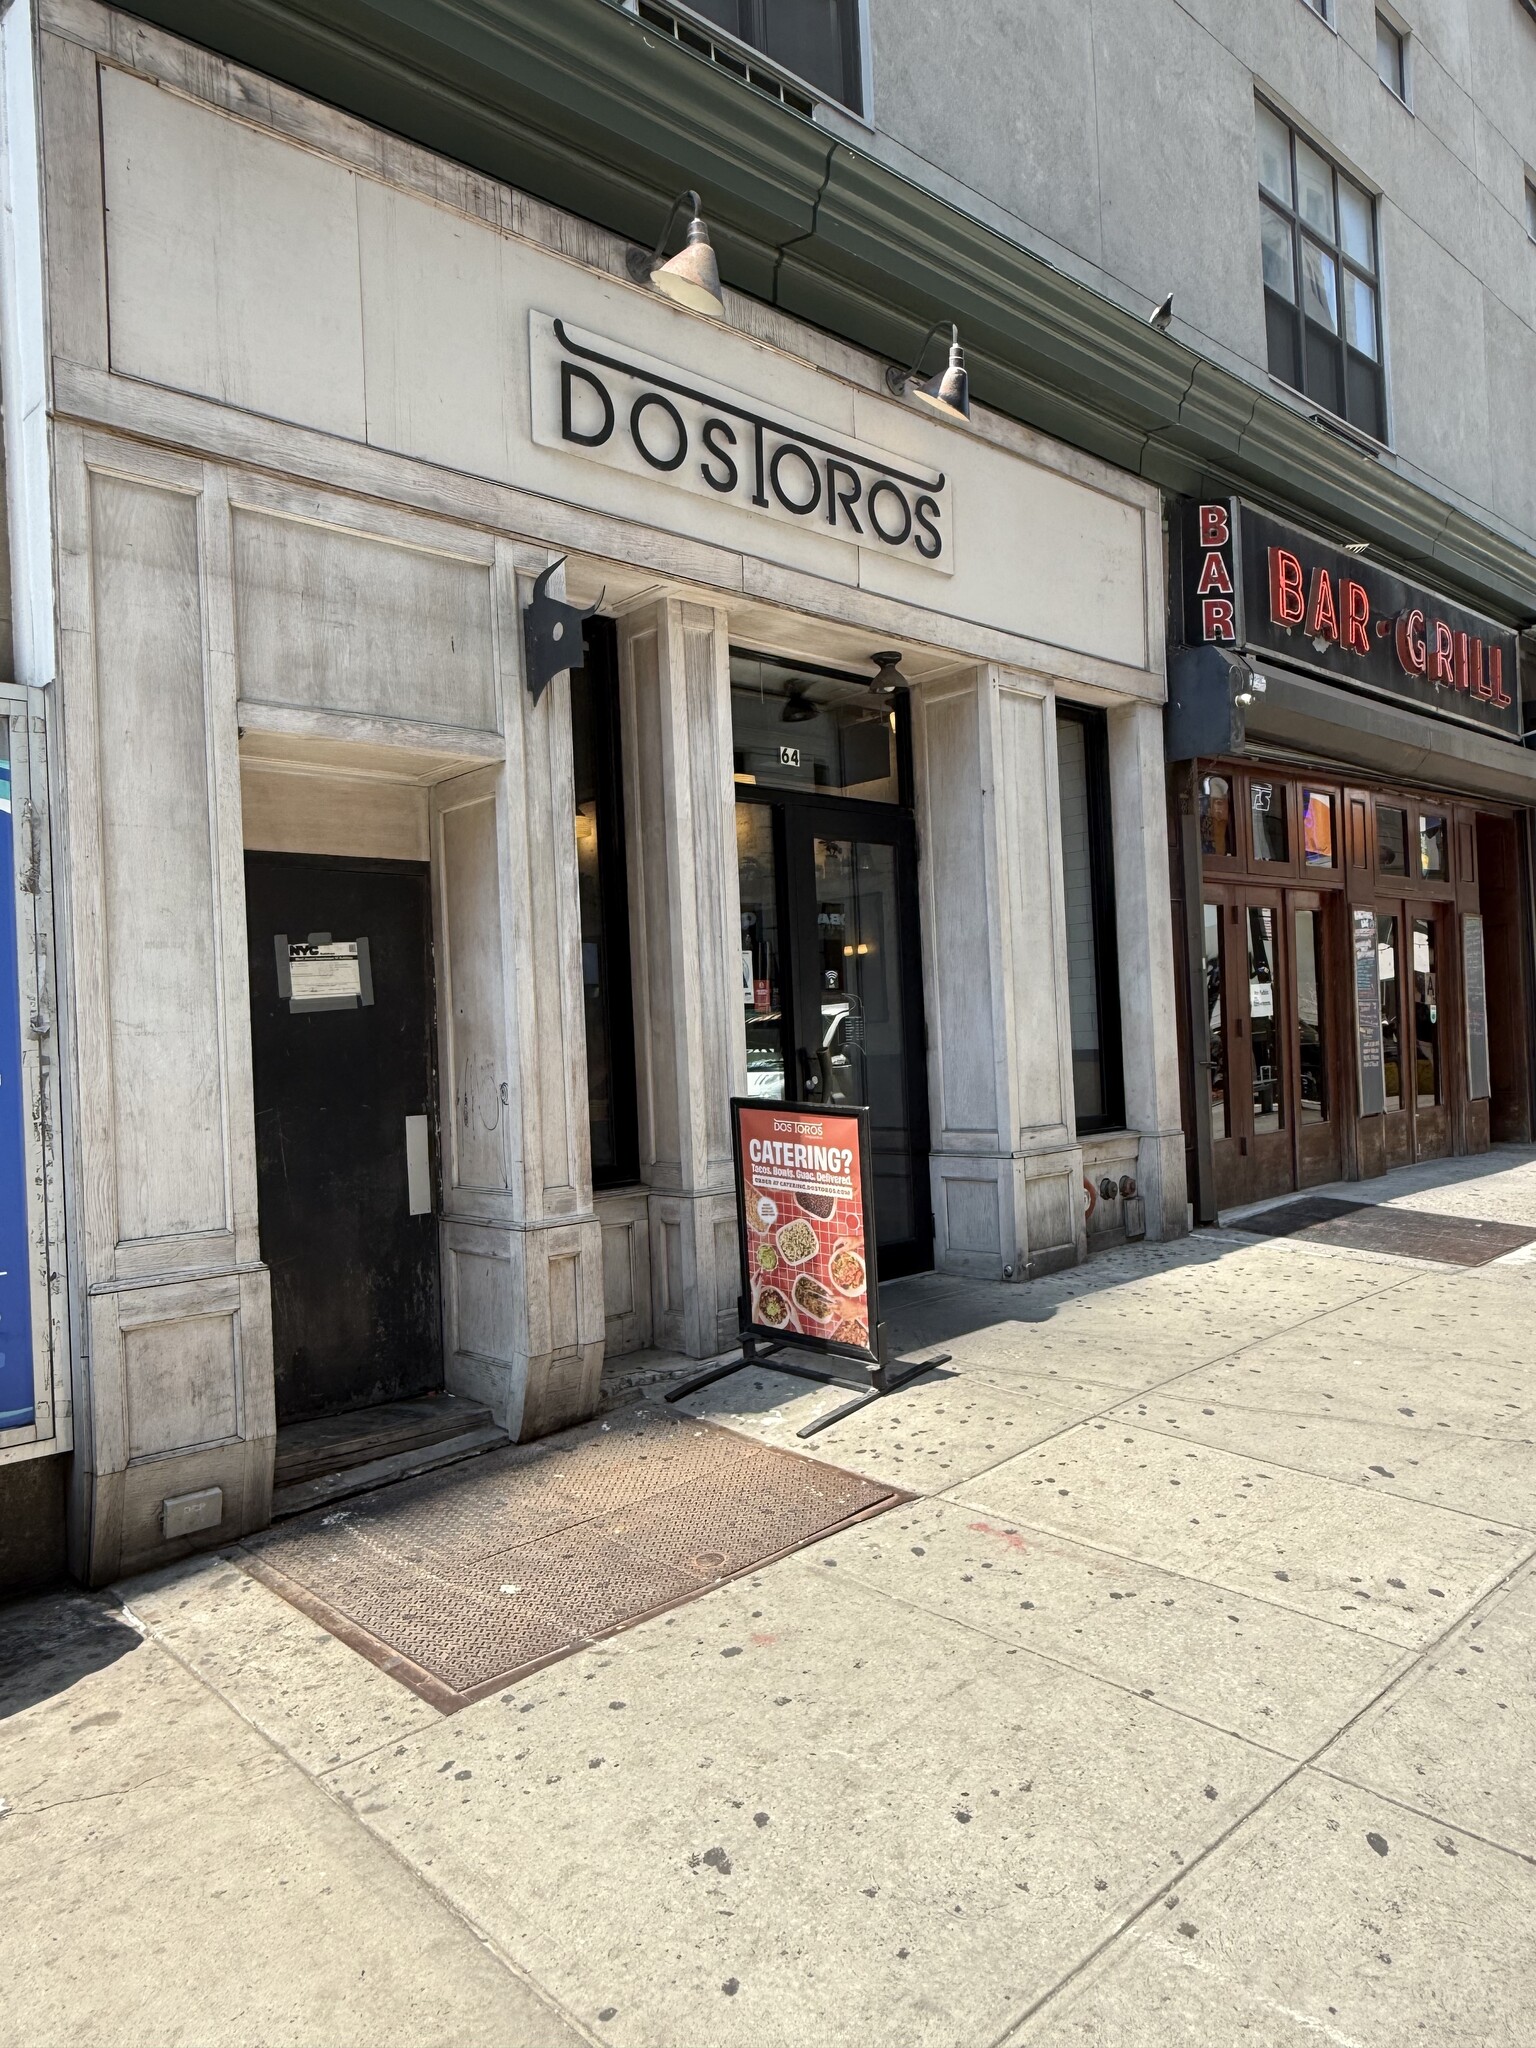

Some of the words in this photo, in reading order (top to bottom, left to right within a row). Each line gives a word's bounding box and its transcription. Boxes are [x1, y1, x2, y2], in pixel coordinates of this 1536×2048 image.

[560, 360, 739, 493] DOS
[751, 420, 943, 560] TOROS
[1197, 504, 1234, 641] BAR
[1268, 546, 1370, 656] BAR
[1396, 609, 1512, 709] GRILL
[781, 747, 798, 766] 64
[289, 945, 320, 956] NYC
[773, 1121, 792, 1133] DOS
[794, 1121, 823, 1136] TOROS
[749, 1138, 853, 1175] CATERING?
[751, 1163, 772, 1175] Tacos.
[773, 1167, 795, 1178] Bowls.
[796, 1169, 816, 1181] Guac.
[816, 1172, 853, 1185] Delivered.
[754, 1177, 772, 1185] ORDER
